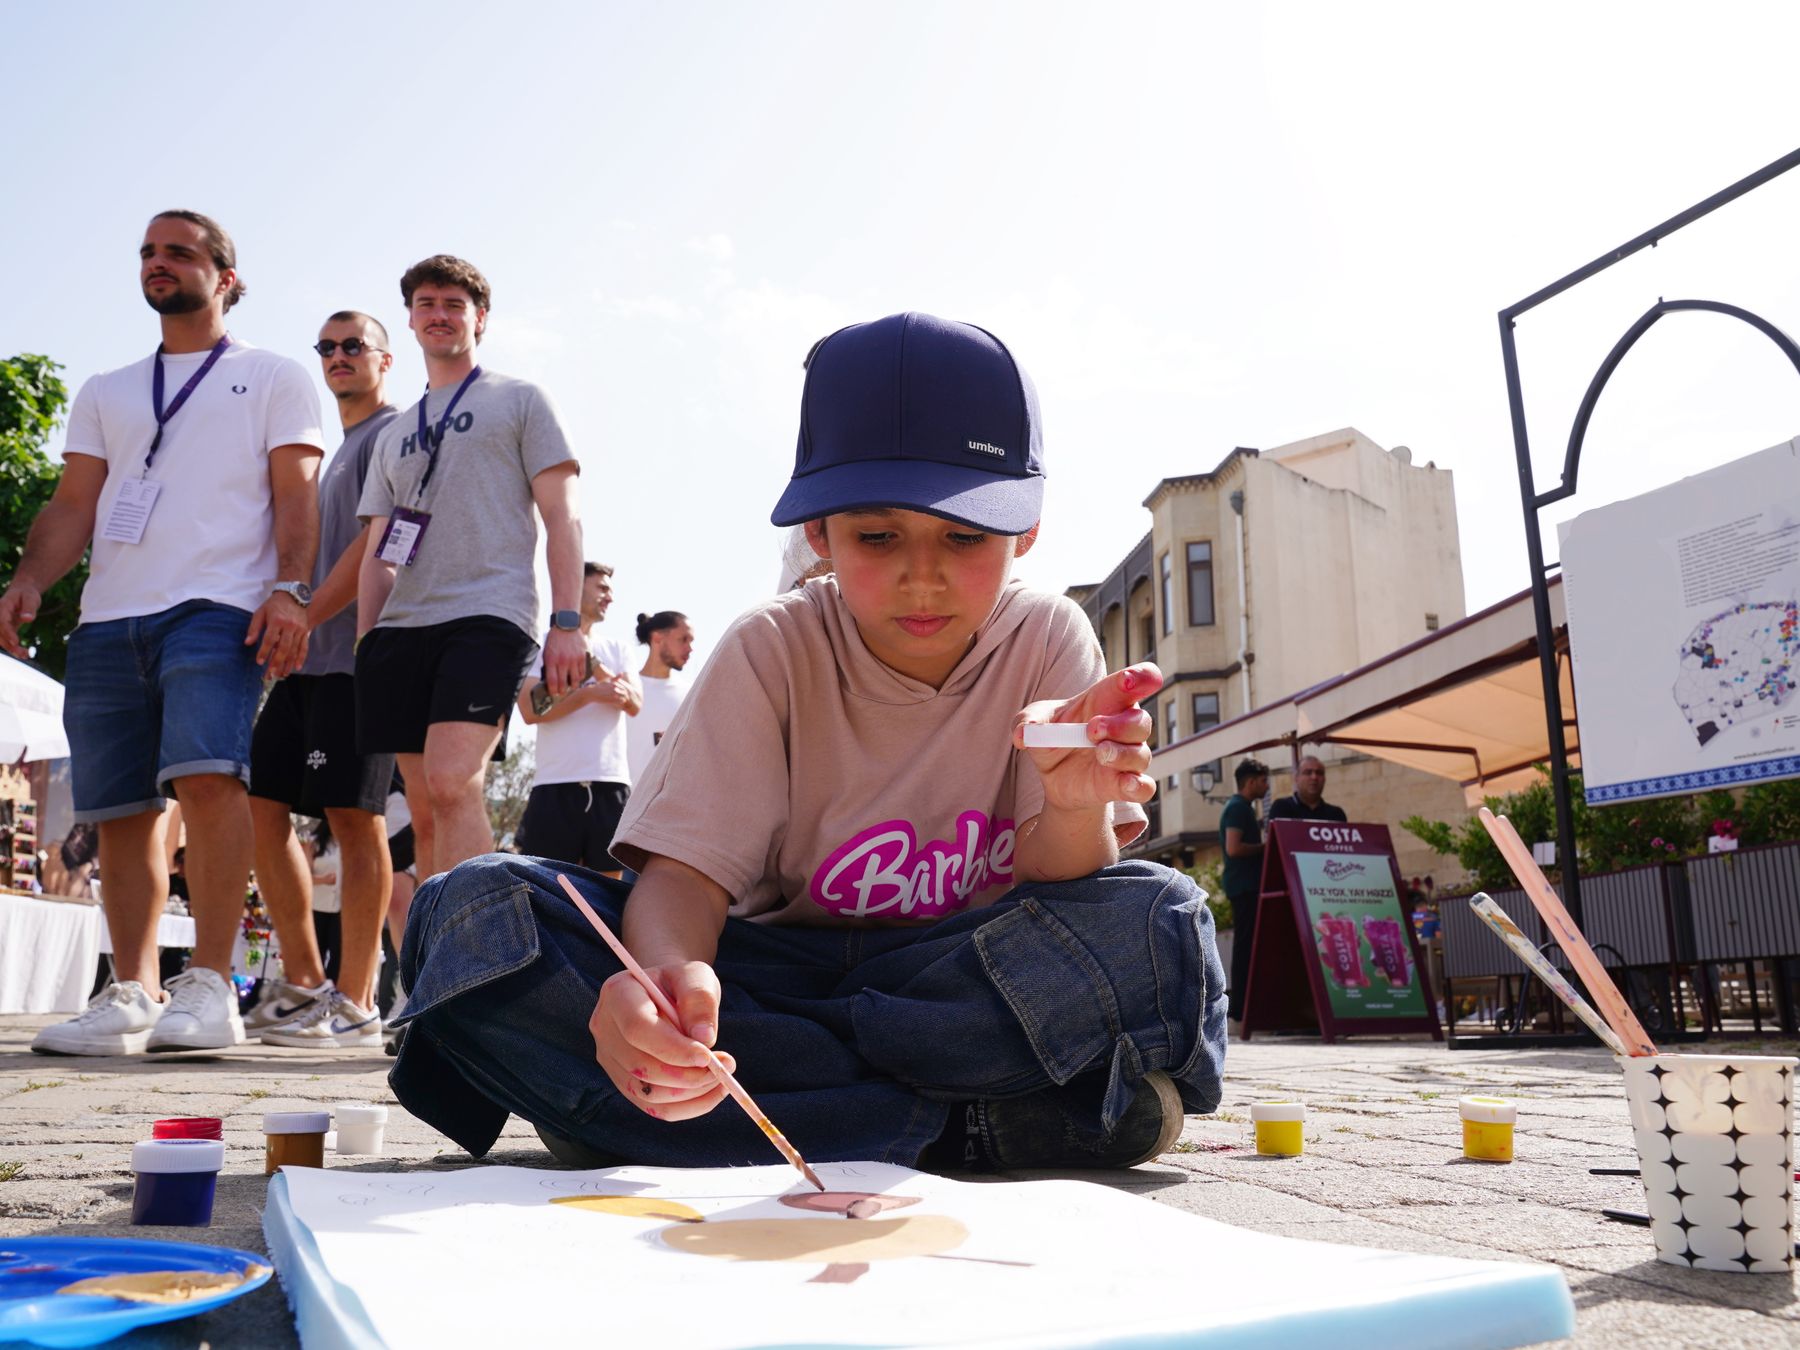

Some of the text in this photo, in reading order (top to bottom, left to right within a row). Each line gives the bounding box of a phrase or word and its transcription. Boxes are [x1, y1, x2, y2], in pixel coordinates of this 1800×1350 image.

[968, 440, 1005, 456] umbro
[1309, 826, 1363, 844] COSTA
[1324, 844, 1354, 852] COFFEE
